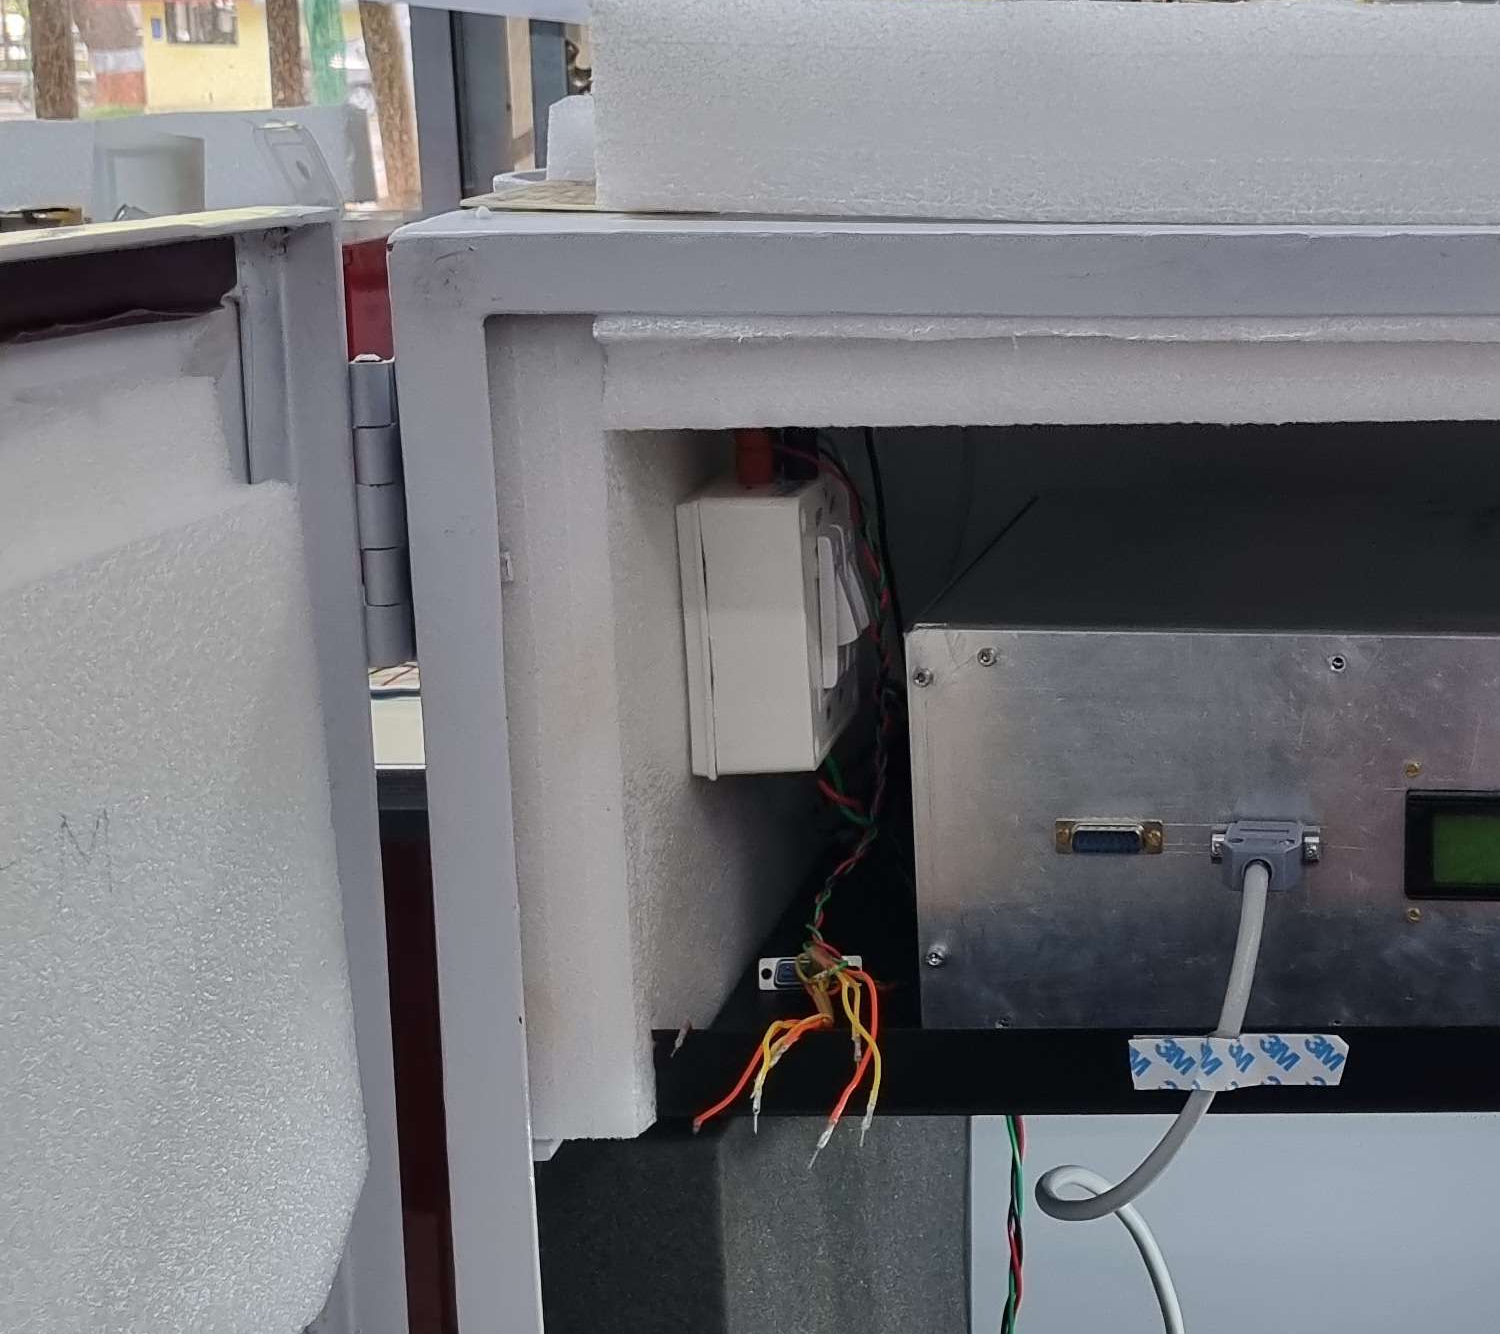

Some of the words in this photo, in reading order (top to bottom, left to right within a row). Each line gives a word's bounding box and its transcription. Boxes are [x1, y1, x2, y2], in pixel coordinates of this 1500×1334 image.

[1155, 1039, 1196, 1076] 3M
[1260, 1035, 1301, 1072] 3M
[1305, 1035, 1346, 1072] 3M
